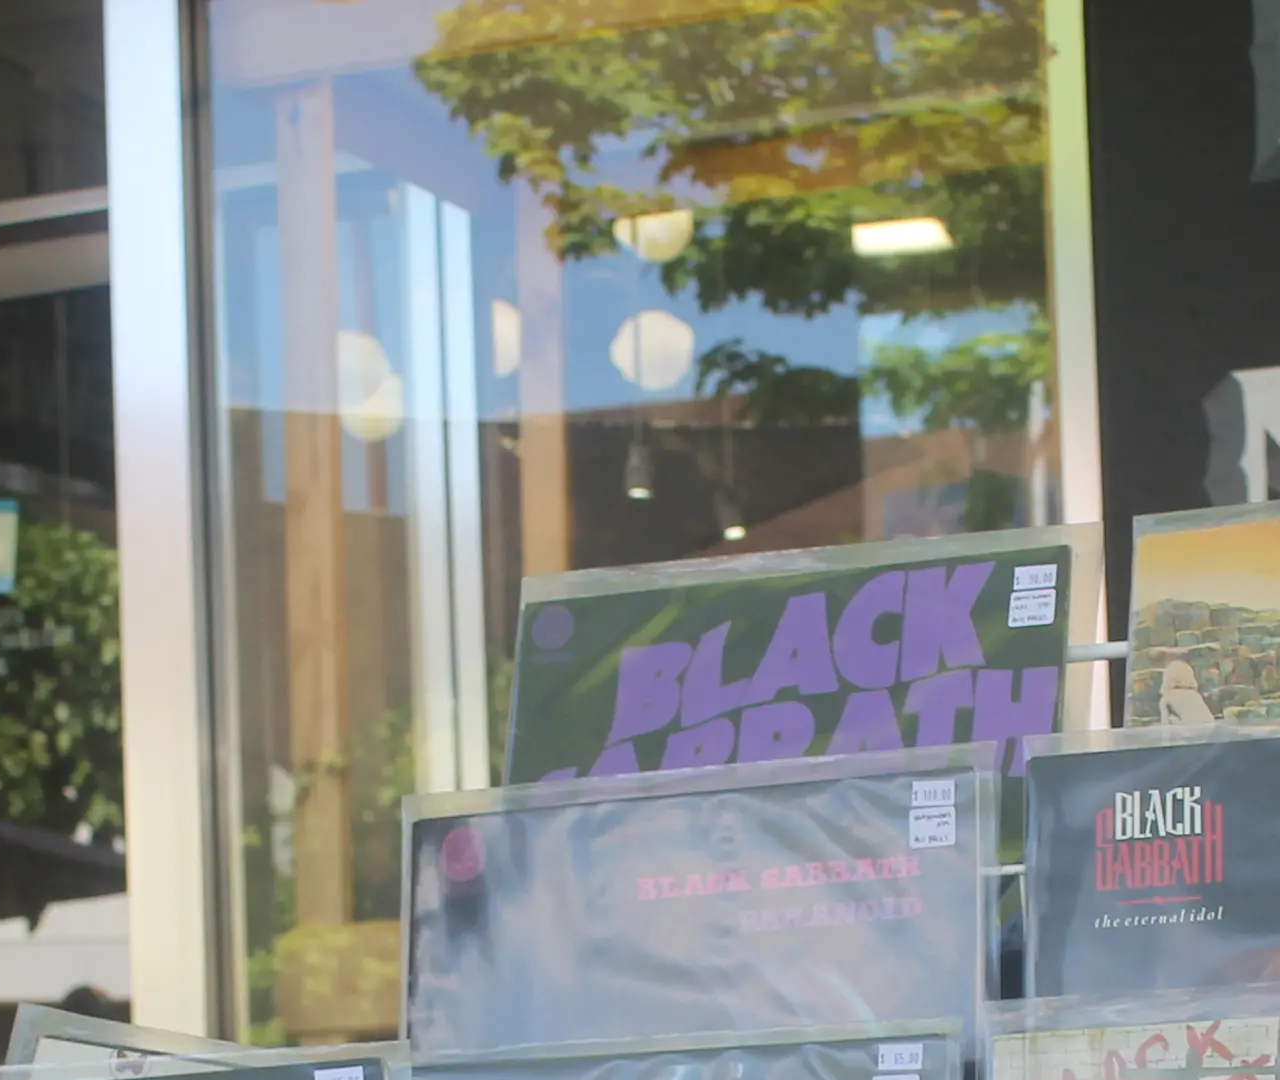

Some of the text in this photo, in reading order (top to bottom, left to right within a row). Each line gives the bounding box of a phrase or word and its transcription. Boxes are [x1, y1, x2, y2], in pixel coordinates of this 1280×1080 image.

[608, 561, 995, 746] BLACK
[1114, 785, 1204, 840] BLACK
[1094, 800, 1225, 892] SABBATH
[637, 854, 921, 901] BLACK SABBATH
[738, 896, 923, 935] PARANOID
[1094, 905, 1224, 929] the eternal idol
